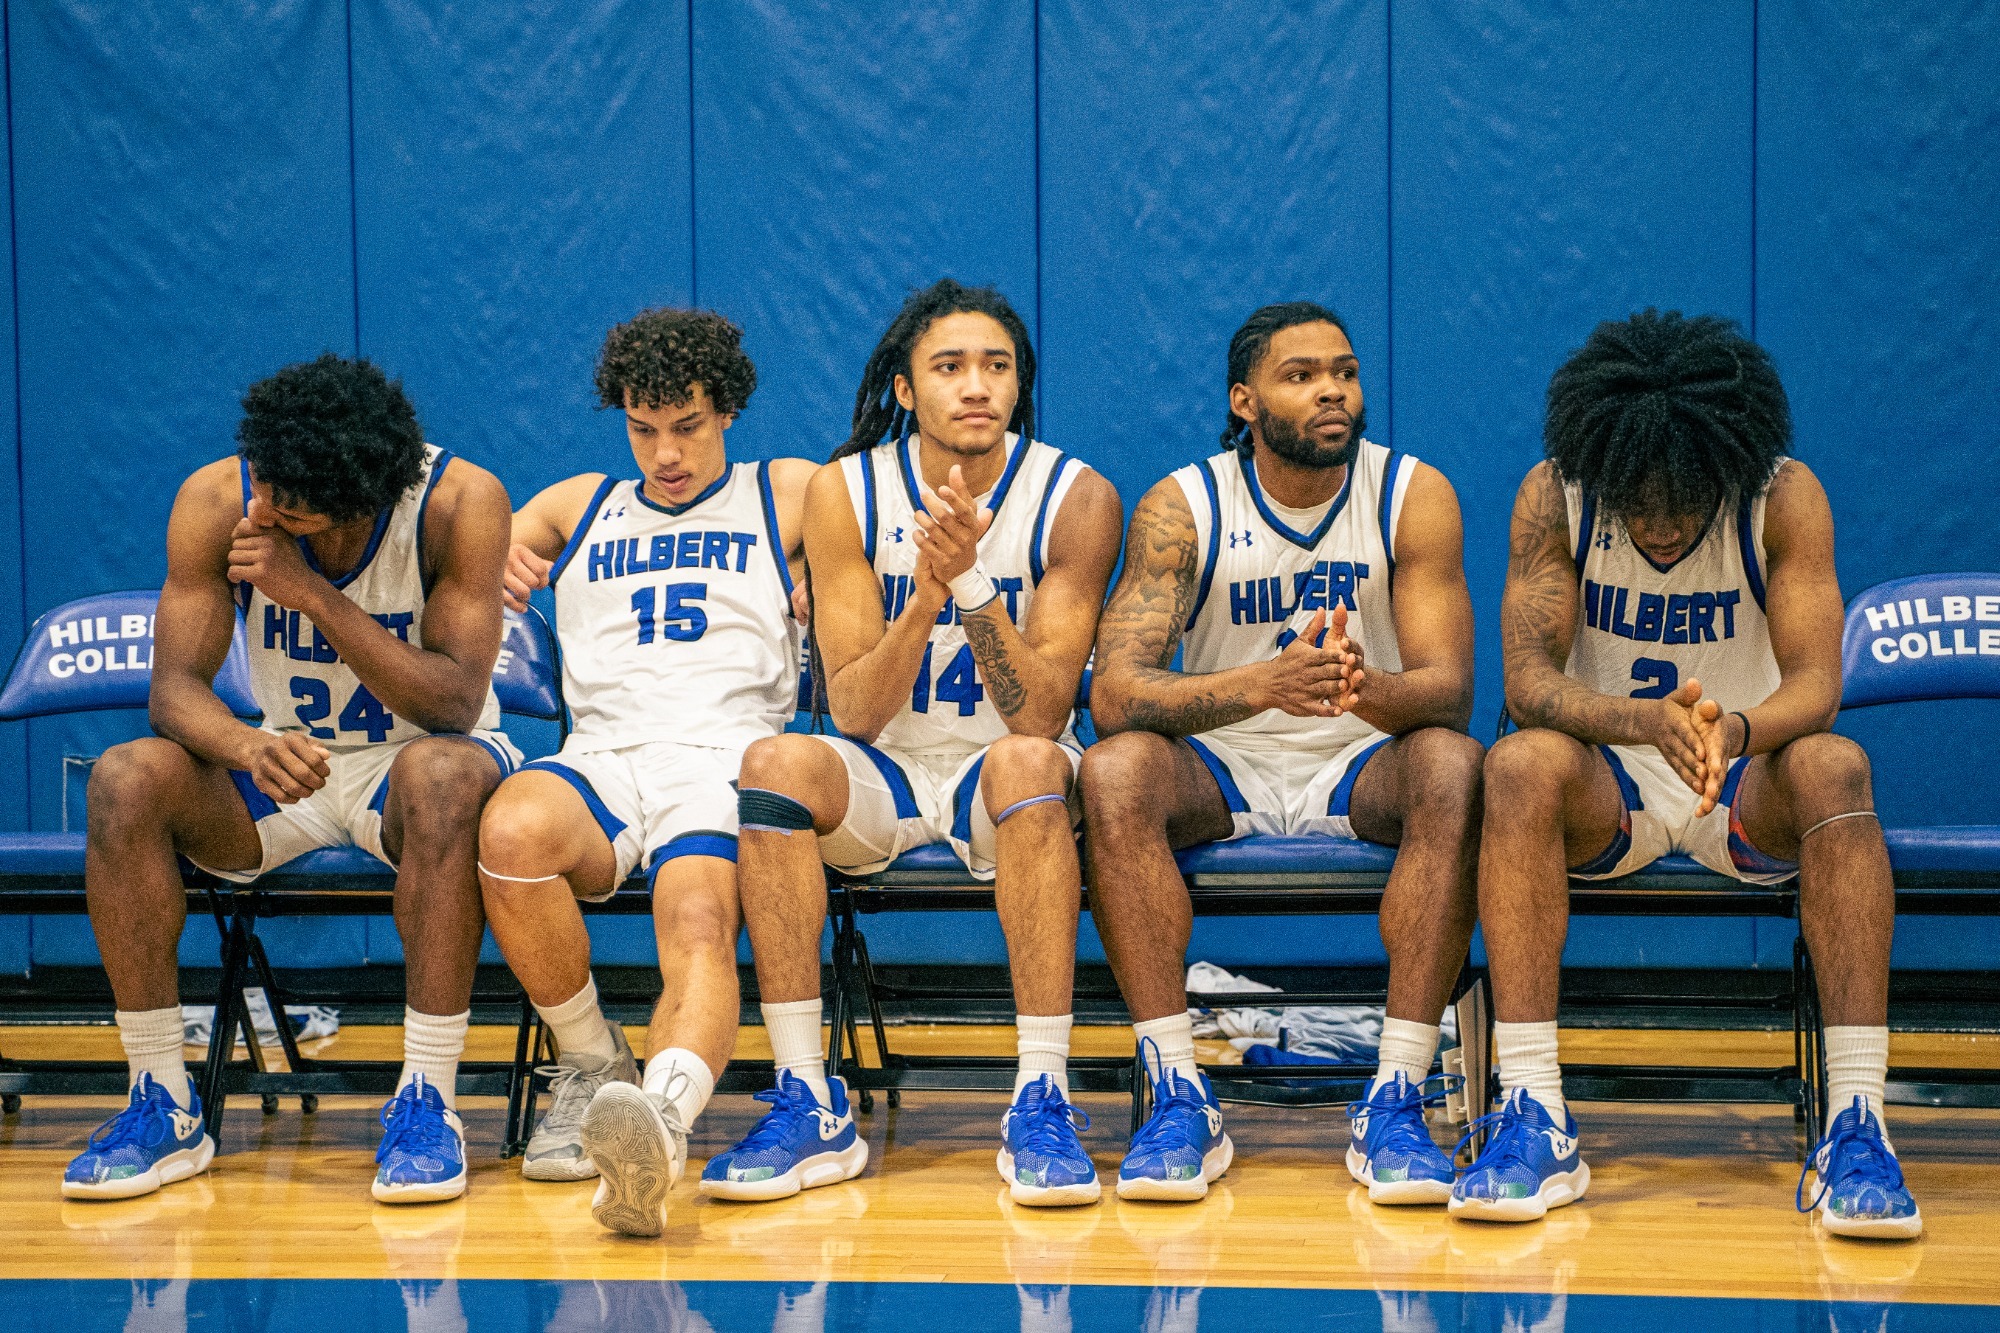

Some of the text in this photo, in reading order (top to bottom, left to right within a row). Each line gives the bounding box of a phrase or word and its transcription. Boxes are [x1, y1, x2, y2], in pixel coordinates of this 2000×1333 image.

[588, 531, 757, 582] HILBERT
[49, 614, 155, 648] HILB
[631, 582, 708, 645] 15
[48, 645, 153, 678] COLL
[912, 641, 983, 717] 14
[1629, 657, 1678, 699] 2
[289, 675, 394, 742] 24
